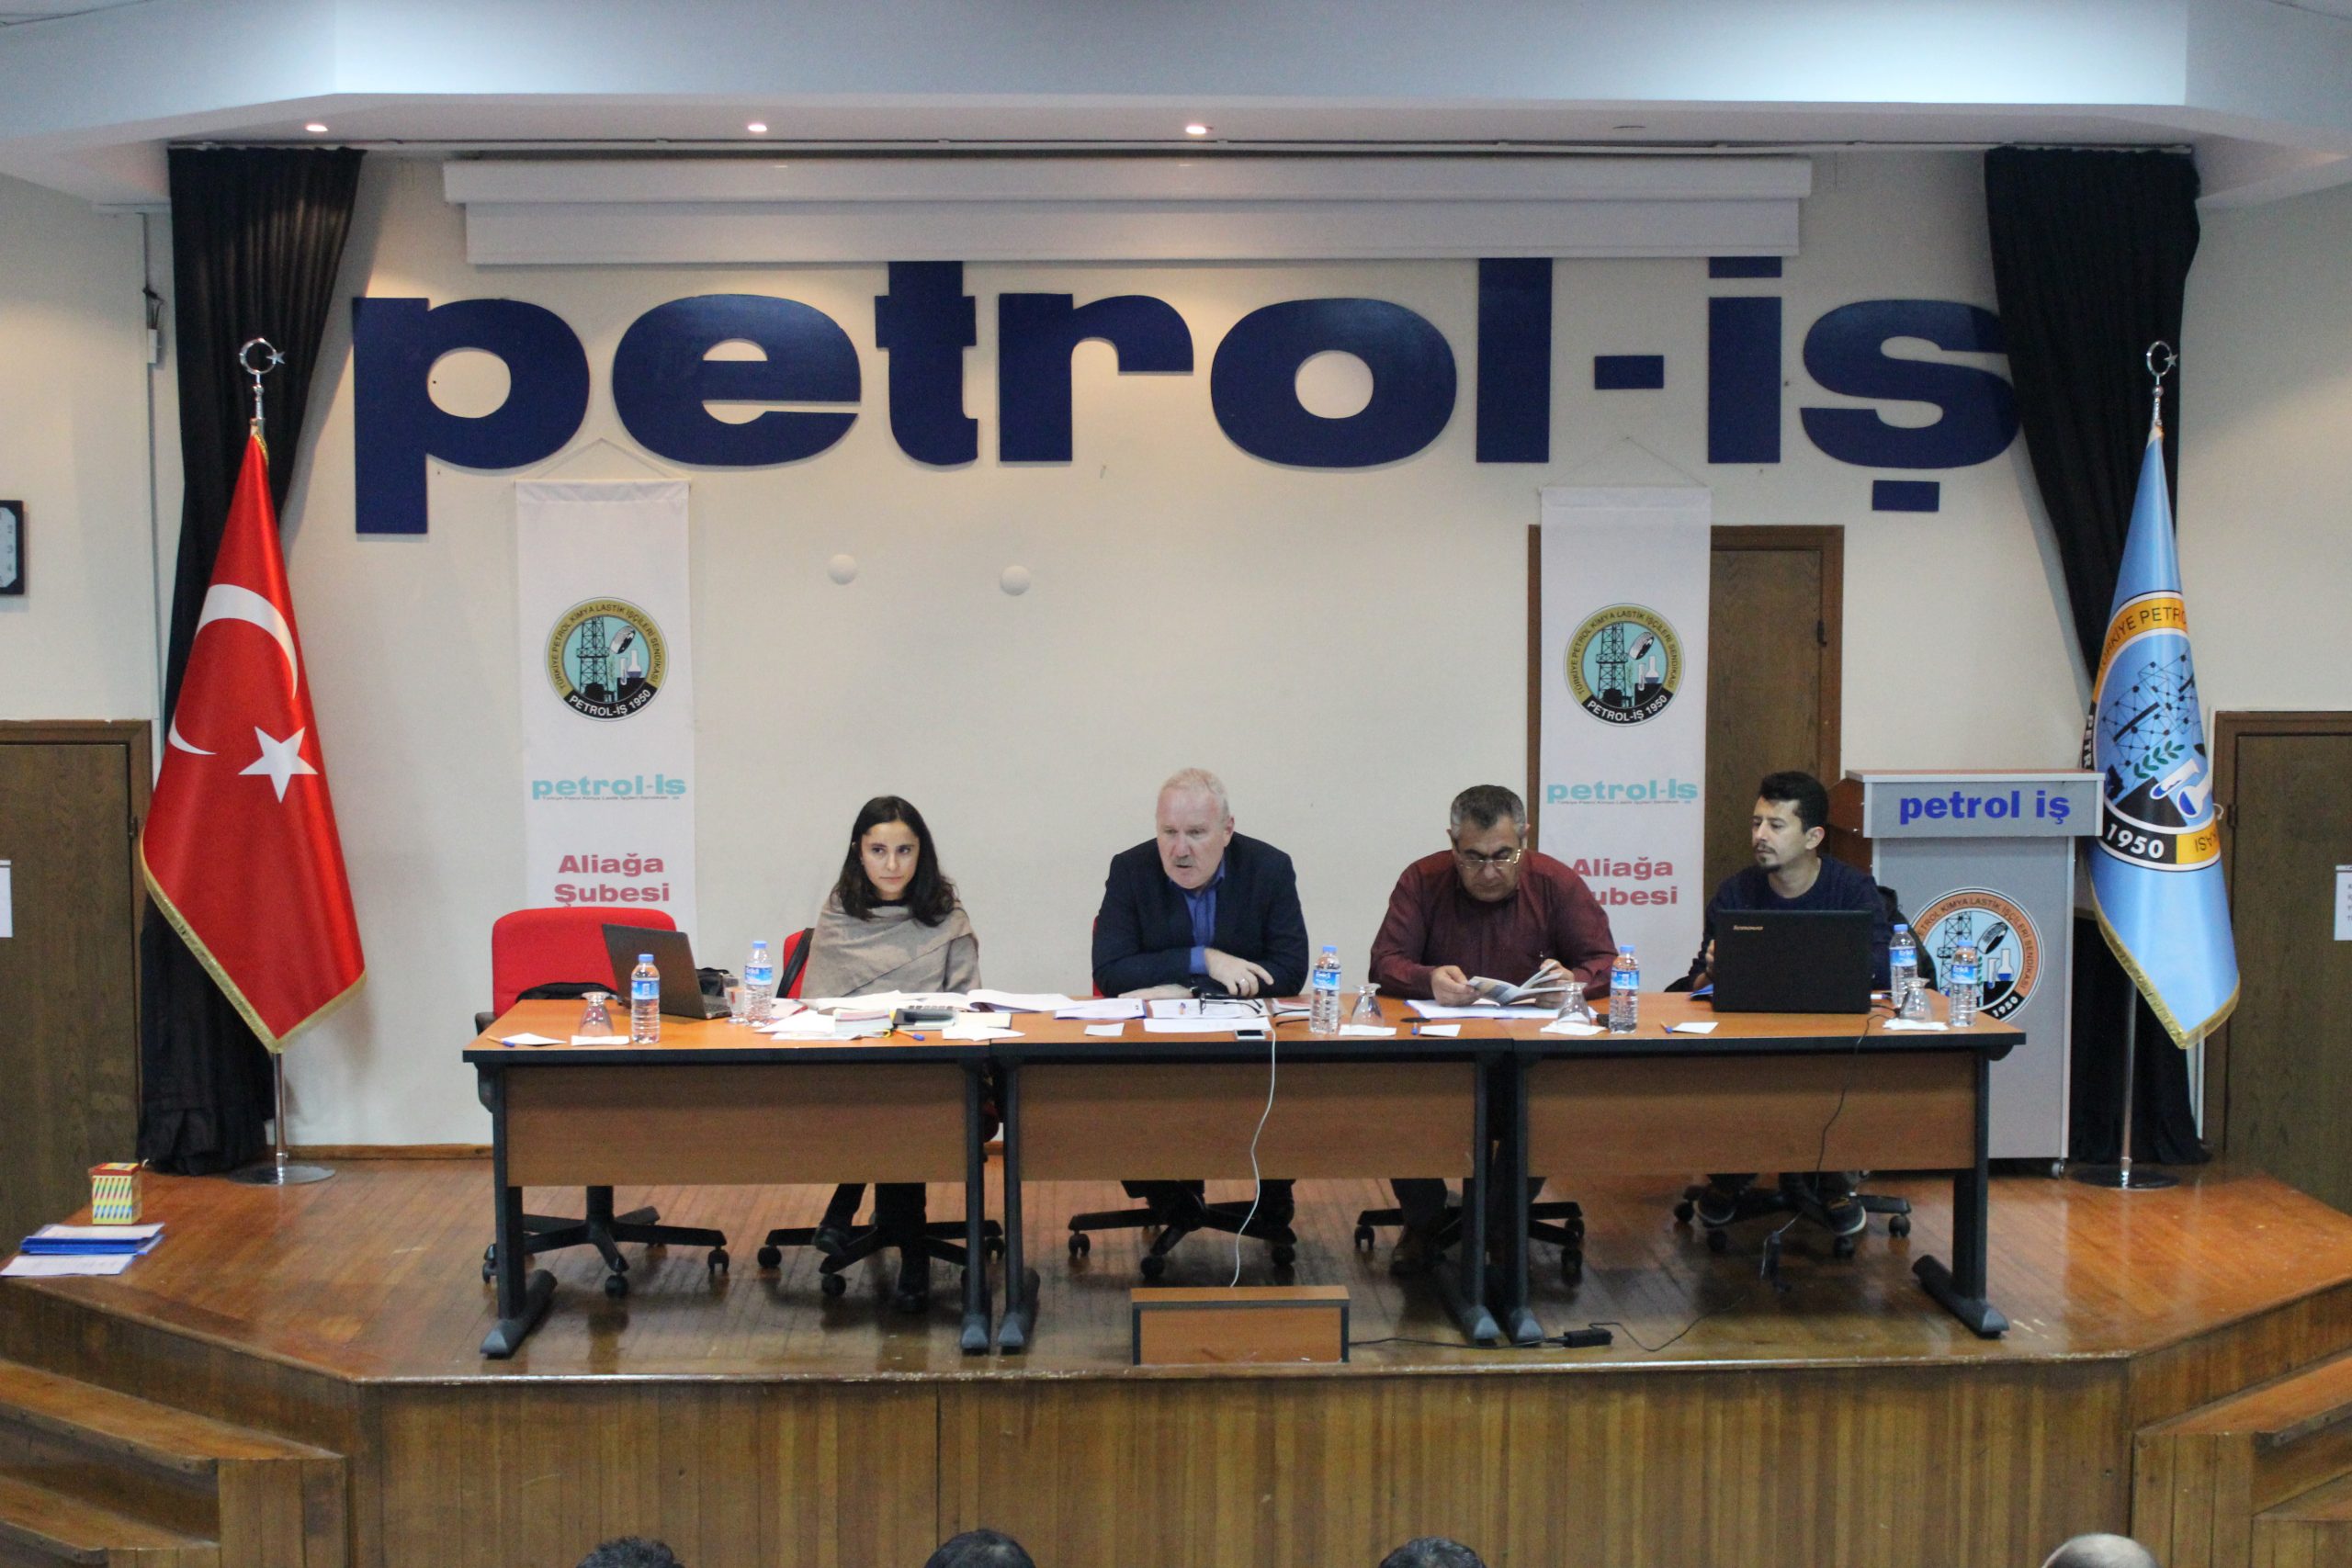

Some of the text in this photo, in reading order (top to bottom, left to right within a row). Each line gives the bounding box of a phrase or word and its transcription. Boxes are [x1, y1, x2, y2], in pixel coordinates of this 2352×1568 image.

[629, 689, 651, 709] 1950
[1645, 694, 1668, 715] 1950
[1899, 790, 2071, 825] petrol iş
[2107, 824, 2165, 859] 1950
[558, 852, 664, 877] Aliağa
[1572, 856, 1673, 881] Aliağa
[554, 883, 670, 908] Şubesi
[1591, 886, 1678, 906] ubesi
[1992, 996, 2018, 1018] 1950
